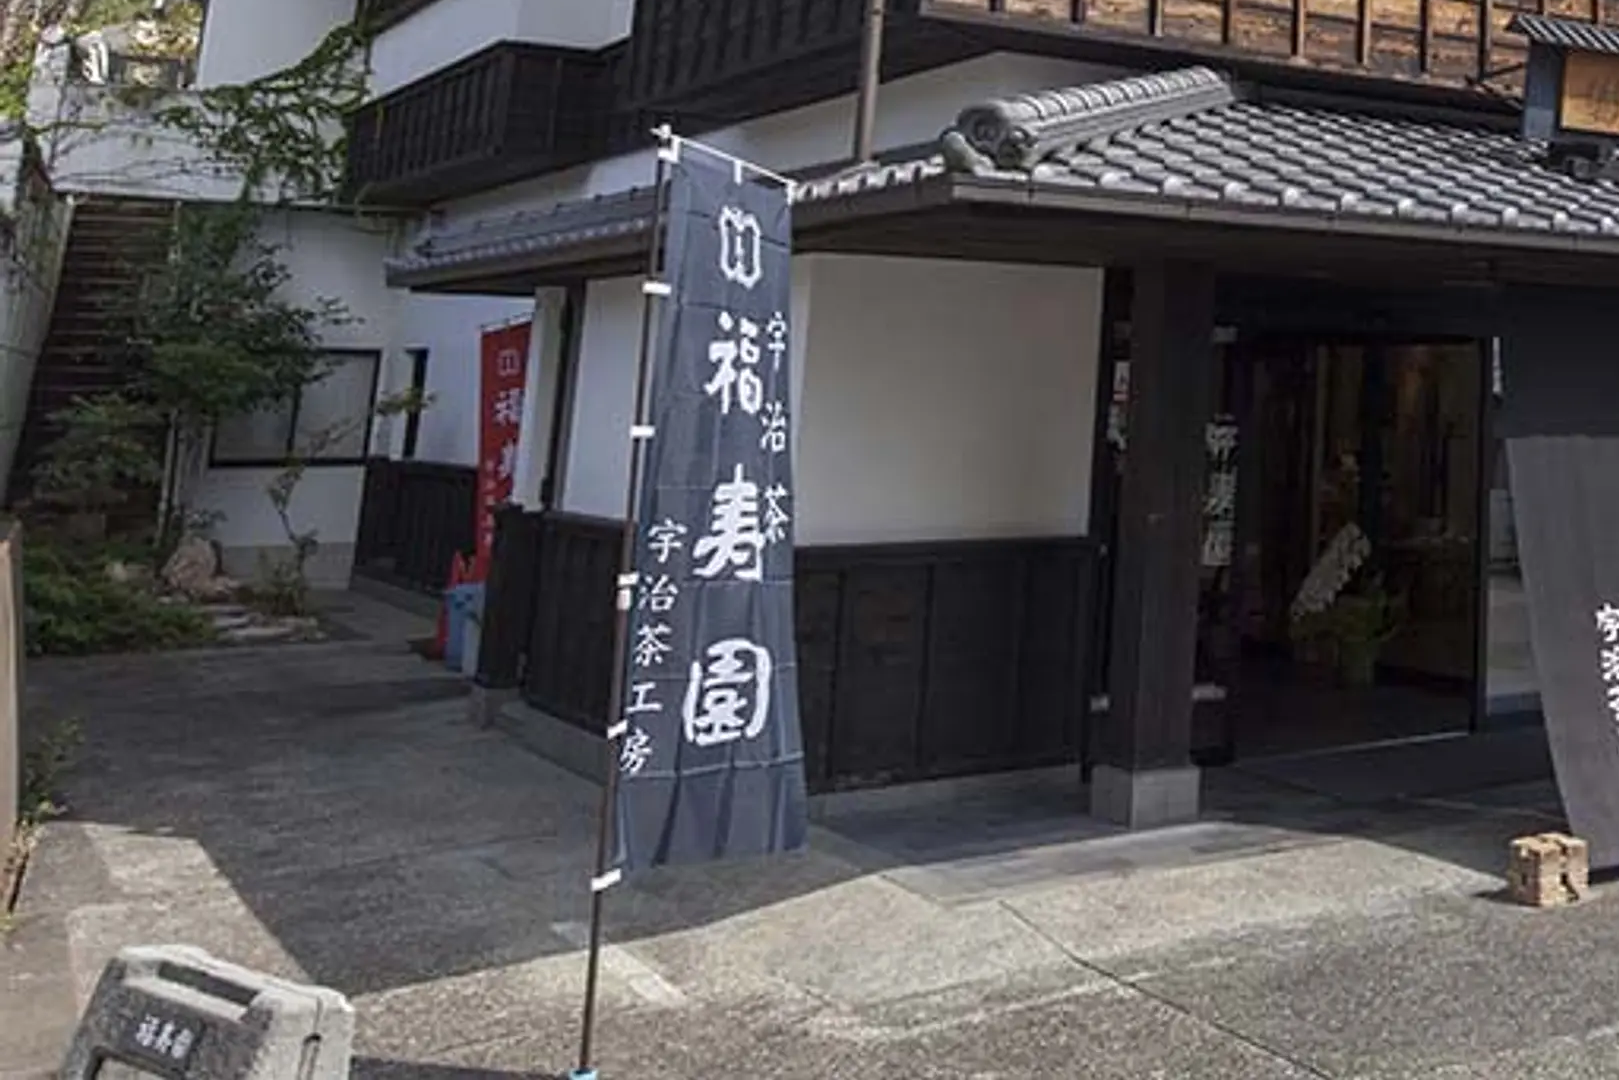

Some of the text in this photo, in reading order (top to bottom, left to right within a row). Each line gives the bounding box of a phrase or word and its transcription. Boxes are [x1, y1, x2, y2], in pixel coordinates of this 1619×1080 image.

[682, 310, 769, 746] 福寿園
[760, 310, 789, 544] 宇治茶
[616, 518, 690, 776] 宇治茶工房
